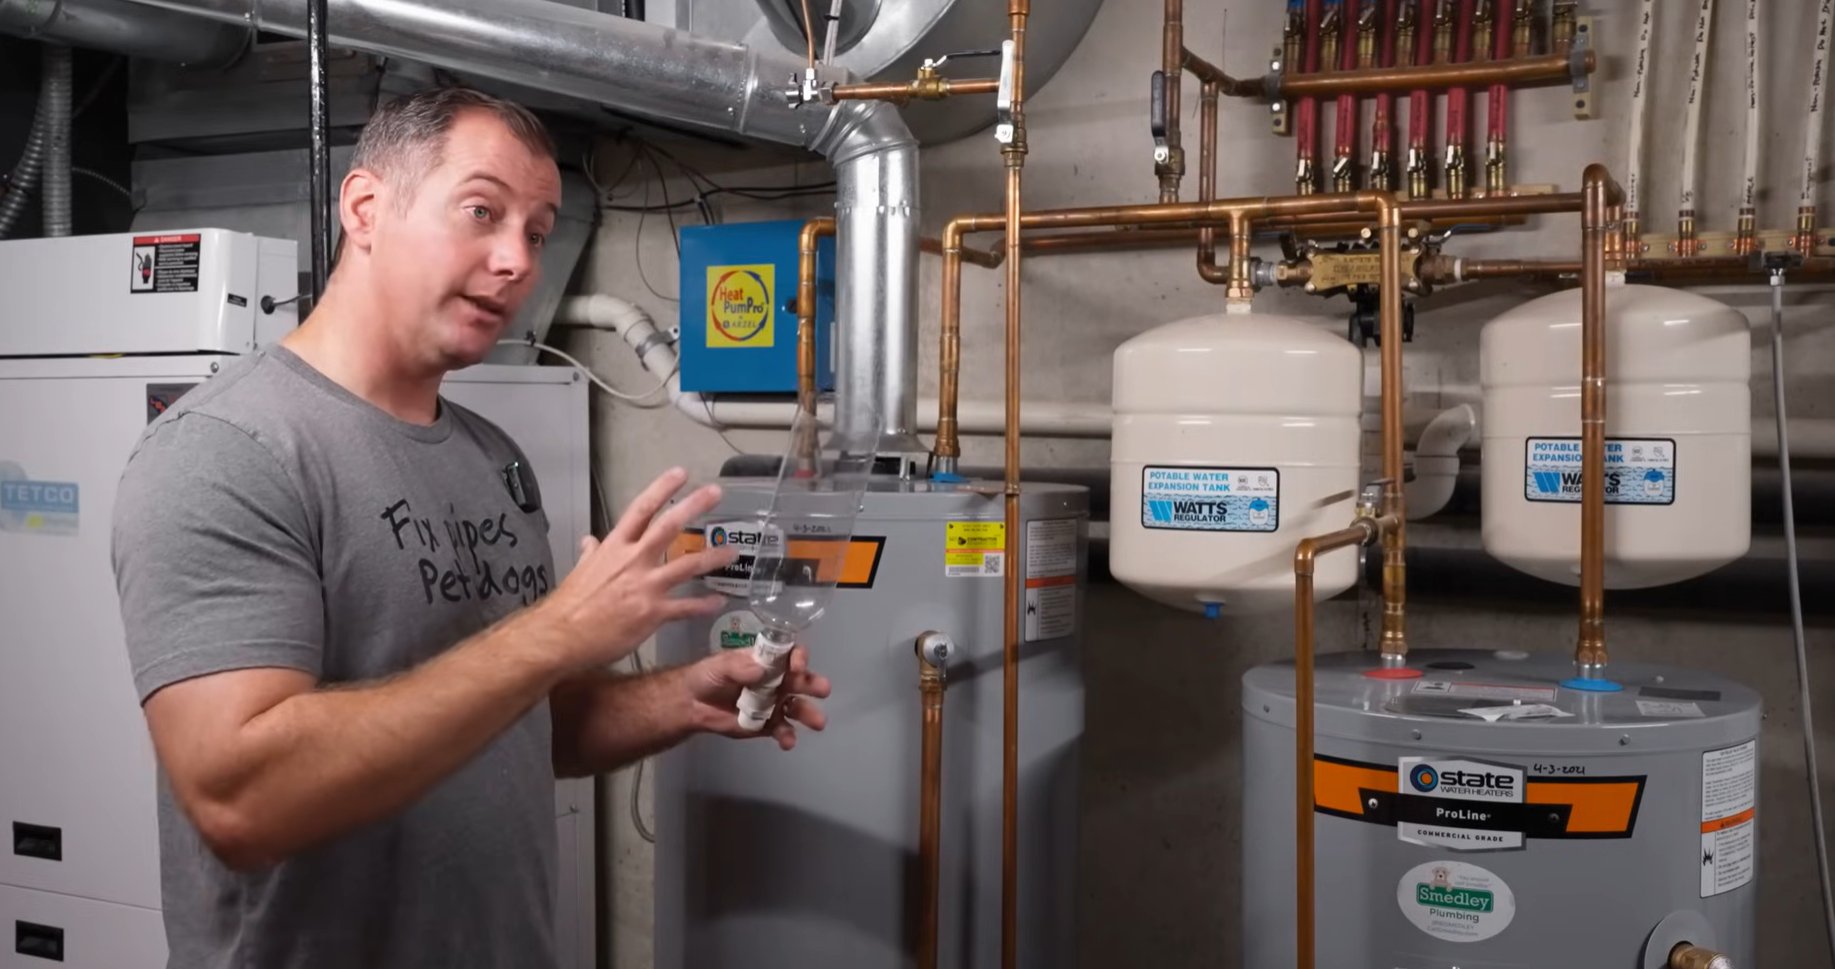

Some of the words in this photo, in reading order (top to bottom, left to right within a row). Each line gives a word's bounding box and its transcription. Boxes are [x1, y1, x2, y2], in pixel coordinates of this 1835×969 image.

[720, 287, 744, 301] Heat
[1534, 442, 1580, 452] POTABLE
[1533, 453, 1583, 463] EXPANSIO
[1149, 471, 1190, 481] POTABLE
[1193, 473, 1229, 482] WATER
[1561, 472, 1621, 487] WAS
[3, 484, 74, 504] TETCO
[1148, 482, 1200, 491] EXPANSION
[1202, 482, 1231, 492] TANK
[1561, 485, 1619, 494] REGOR
[1173, 501, 1228, 515] WATTS
[380, 498, 440, 553] Fix
[1173, 514, 1227, 523] REGULATOR
[418, 557, 471, 605] Pet
[477, 559, 549, 607] dogs
[1533, 763, 1586, 775] 4-3-2021
[1440, 770, 1515, 790] state
[1440, 785, 1471, 795] WATER
[1472, 787, 1514, 798] HEATERS
[1417, 829, 1471, 841] COMMERCIAL
[1475, 834, 1504, 843] GRADE
[1419, 887, 1490, 911] Smedley
[1430, 908, 1480, 924] Plumbing
